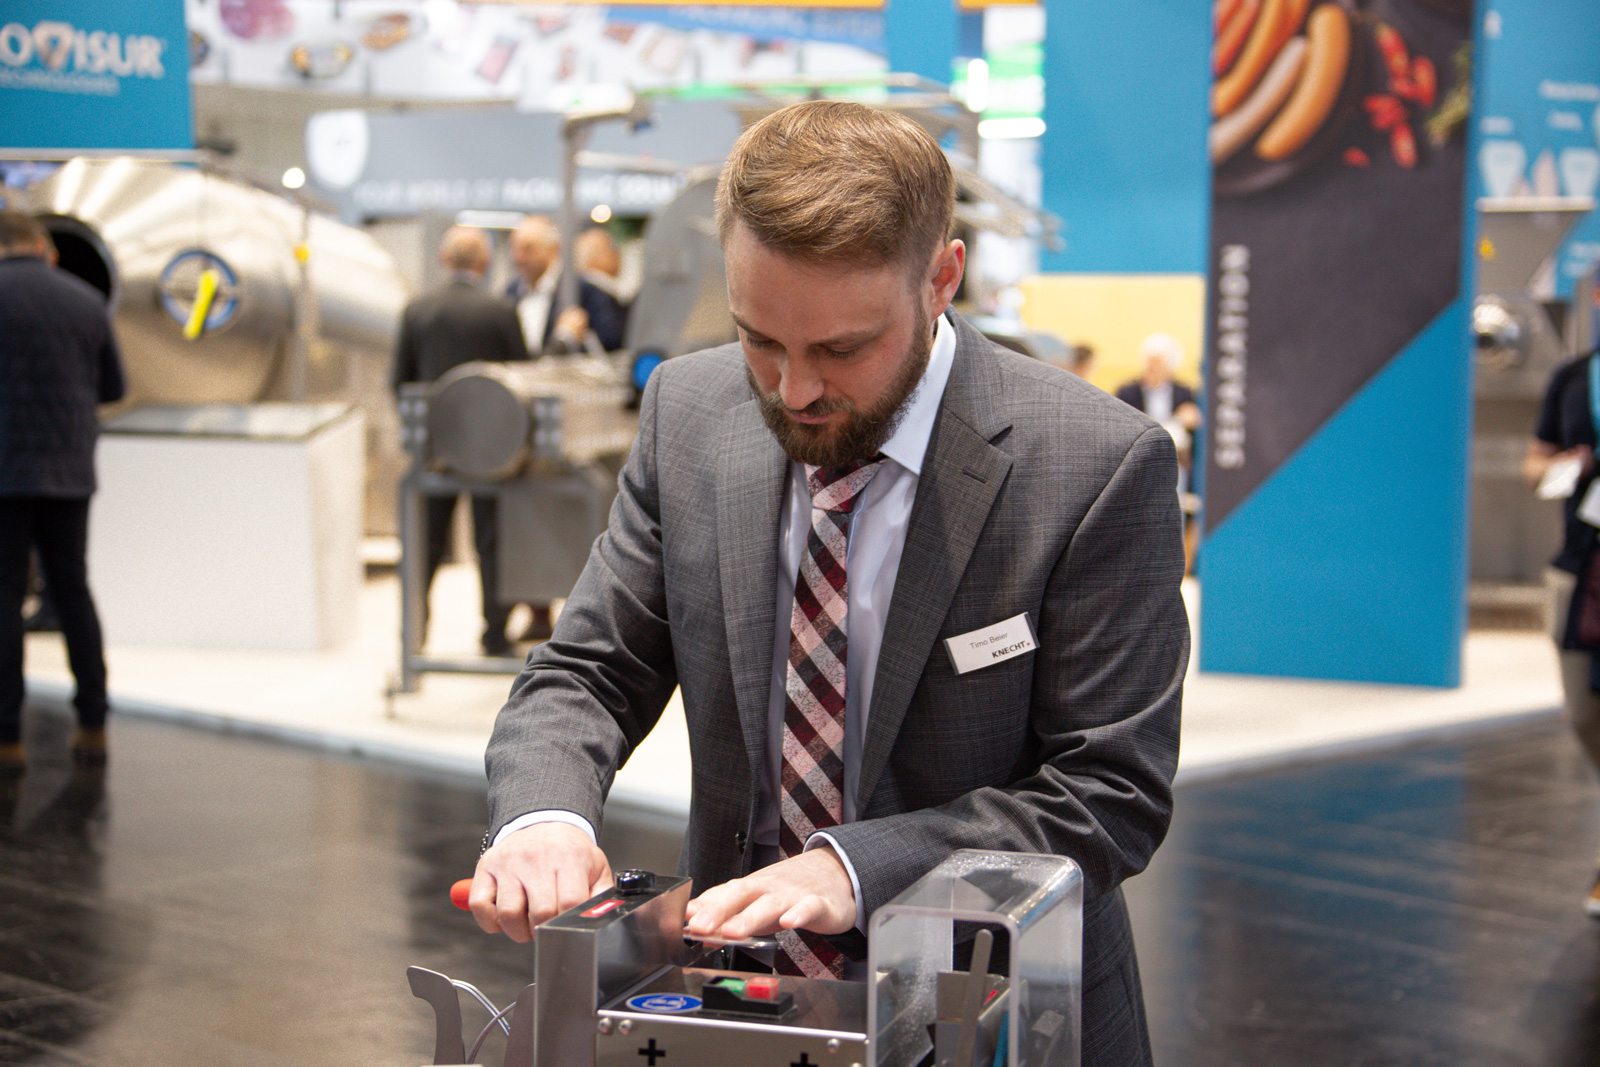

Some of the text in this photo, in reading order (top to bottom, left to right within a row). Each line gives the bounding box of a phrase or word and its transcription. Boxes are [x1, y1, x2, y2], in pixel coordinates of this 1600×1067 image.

[1215, 245, 1249, 468] SEPARATION
[969, 632, 1009, 649] Timo Beier
[991, 640, 1026, 658] KNECHT
